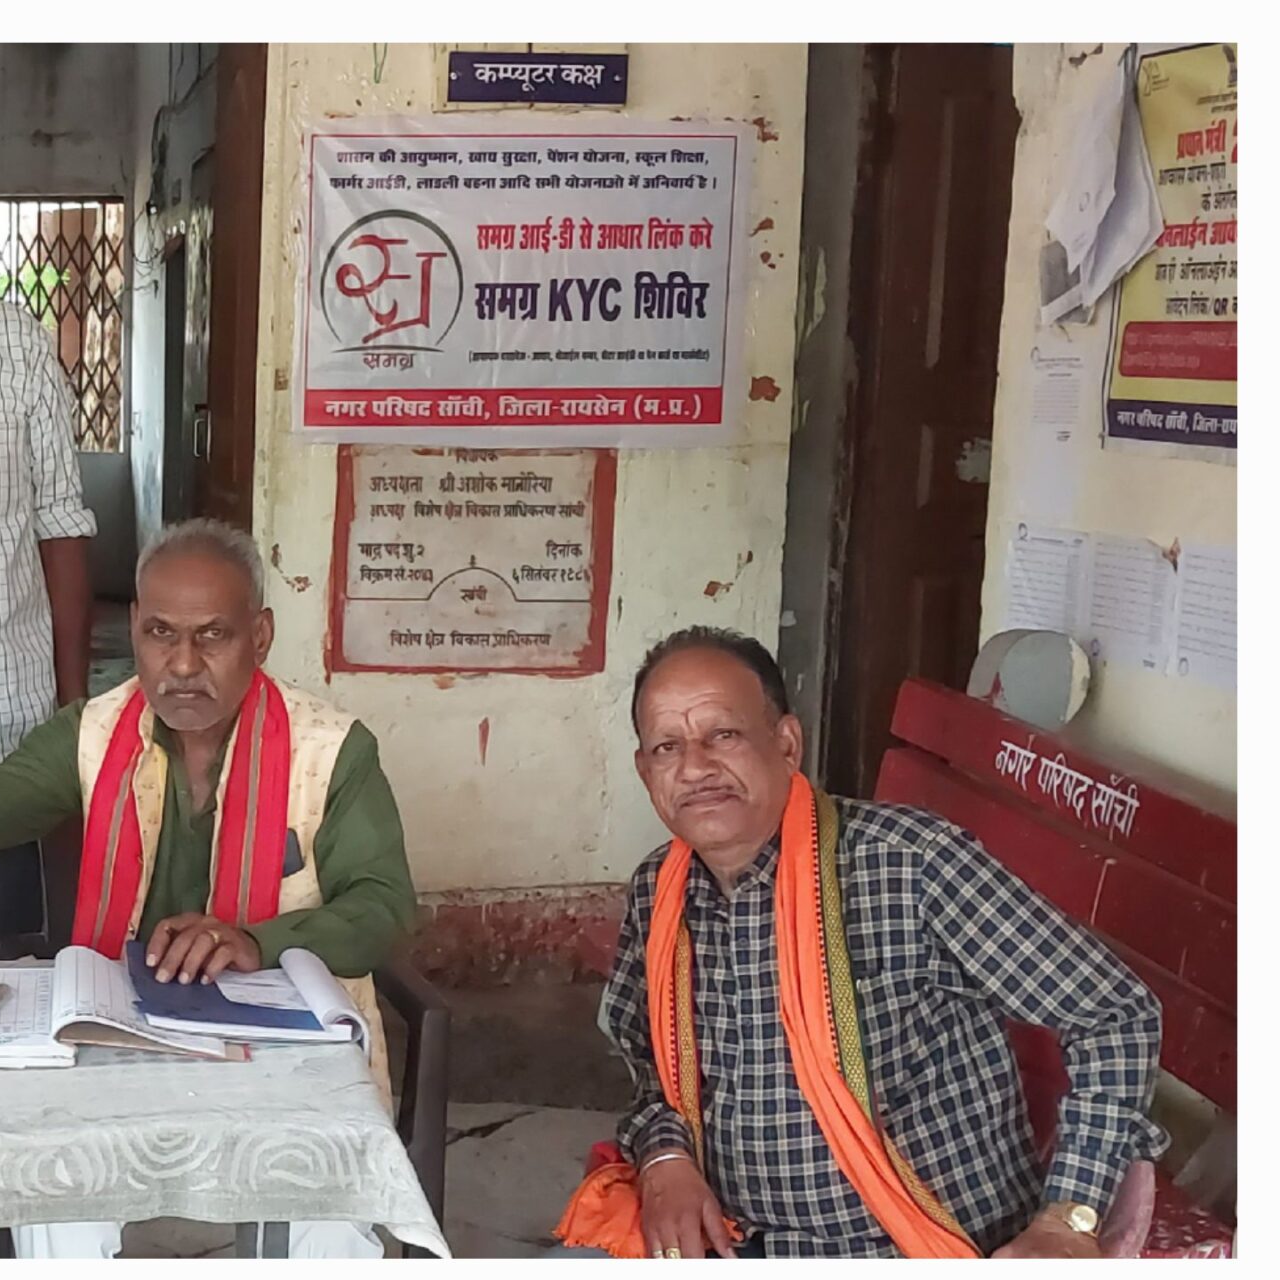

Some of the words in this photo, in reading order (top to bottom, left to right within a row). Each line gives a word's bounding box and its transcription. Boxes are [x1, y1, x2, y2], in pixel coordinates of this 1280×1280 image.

[473, 63, 558, 91] कम्प्यूटर
[560, 64, 605, 88] कक्ष
[379, 149, 395, 163] की
[635, 152, 666, 166] स्कूल
[417, 175, 459, 189] लाडली
[500, 175, 530, 189] आदि
[536, 175, 560, 189] सभी
[628, 174, 639, 189] में
[477, 224, 515, 250] समग्र
[520, 216, 575, 253] आई-डी
[579, 217, 593, 250] से
[598, 224, 643, 249] आधार
[648, 217, 685, 250] लिंक
[475, 282, 540, 321] समग्र
[549, 277, 622, 322] KYC
[634, 271, 710, 320] शिविर
[362, 353, 416, 371] समग्र
[325, 399, 367, 418] नगर
[372, 396, 431, 418] परिषद
[498, 394, 624, 420] जिला-रायसेन
[633, 396, 702, 420] (म.प्र.)
[439, 472, 455, 494] श्री
[546, 540, 583, 560] दिनांक
[390, 628, 422, 647] विशेष
[995, 740, 1038, 792] नगर
[1038, 752, 1094, 819] परिषद
